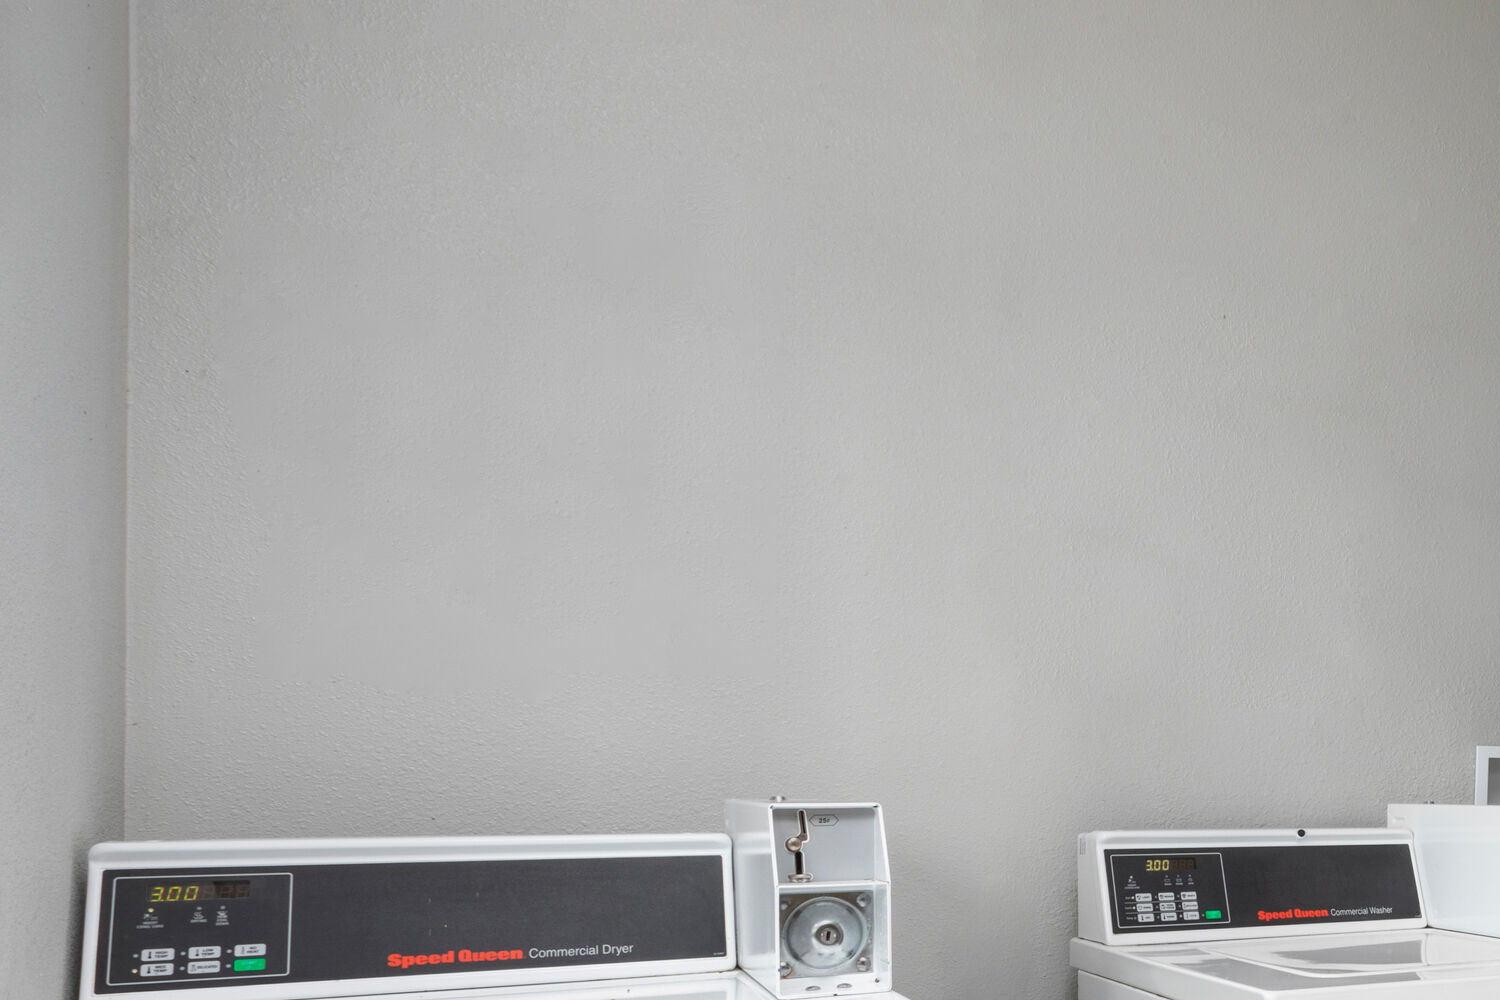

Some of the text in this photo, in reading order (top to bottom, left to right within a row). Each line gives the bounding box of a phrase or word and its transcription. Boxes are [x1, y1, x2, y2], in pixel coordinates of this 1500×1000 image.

[1146, 859, 1170, 871] 3.00
[151, 885, 200, 902] 3.00
[1257, 906, 1393, 921] Speed Queen Commercial Washer
[387, 943, 634, 969] Speed Queen Commercial Dryer
